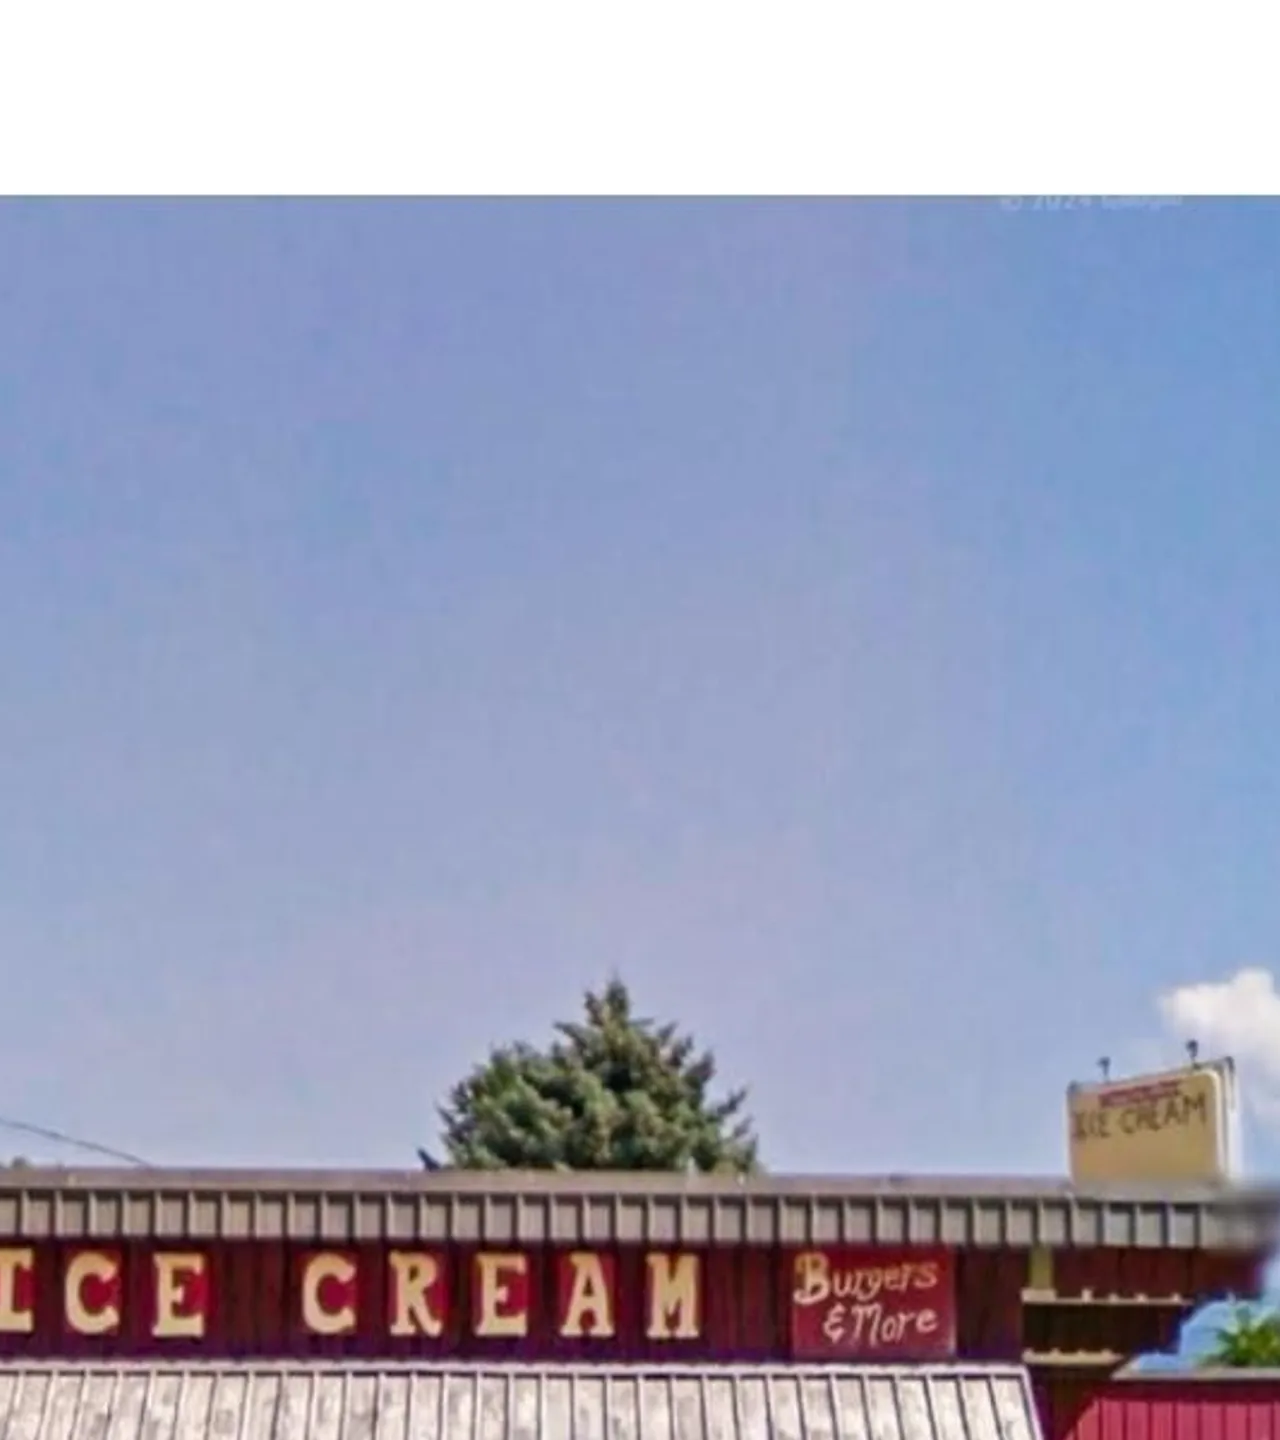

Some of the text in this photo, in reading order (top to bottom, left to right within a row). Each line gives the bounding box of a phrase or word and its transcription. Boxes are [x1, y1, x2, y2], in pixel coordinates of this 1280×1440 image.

[302, 1251, 700, 1339] CREAM
[793, 1252, 938, 1305] Burgers
[851, 1303, 938, 1345] More
